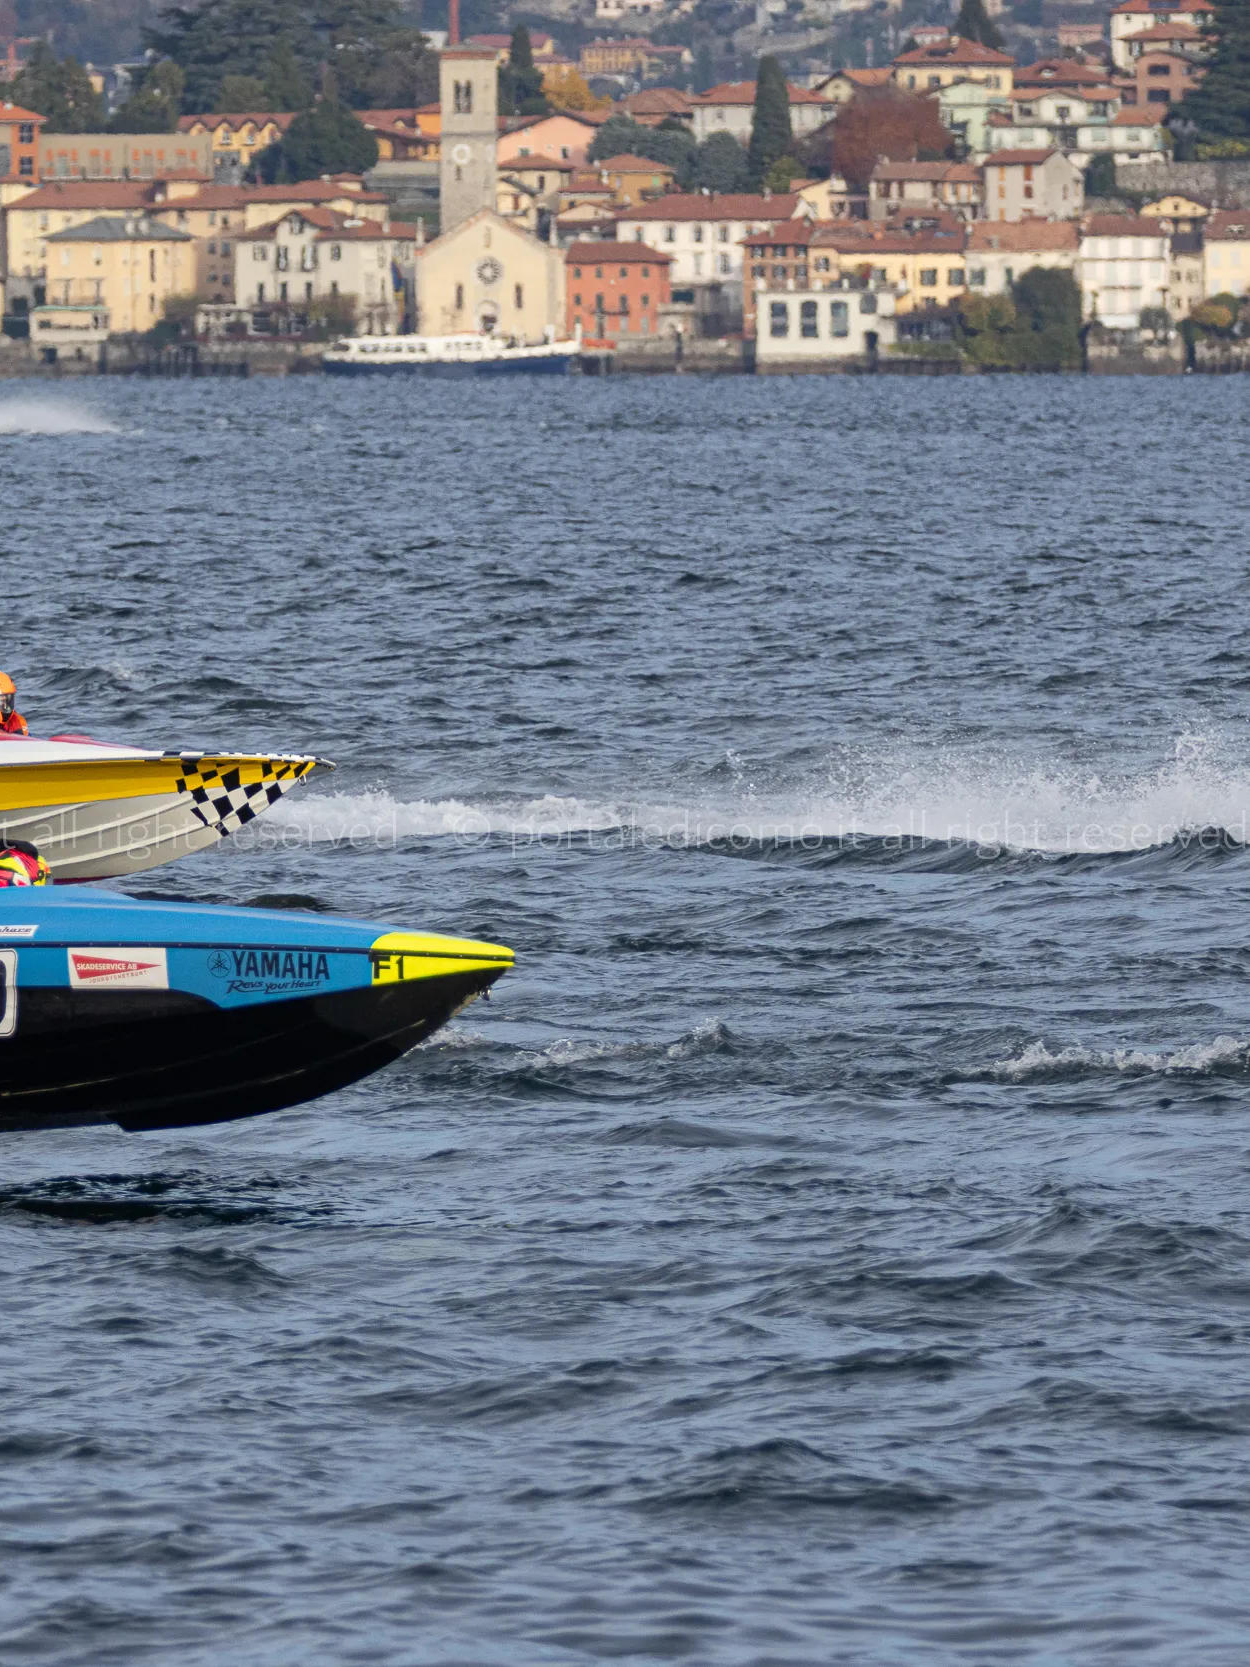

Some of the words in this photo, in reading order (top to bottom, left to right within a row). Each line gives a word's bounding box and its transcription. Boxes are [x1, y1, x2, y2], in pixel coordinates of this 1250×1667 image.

[76, 963, 126, 971] SKADESERVICE
[232, 950, 330, 980] YAMAHA
[373, 954, 405, 980] F1
[225, 979, 263, 994] Revs
[264, 981, 290, 994] your
[291, 979, 322, 989] Heart
